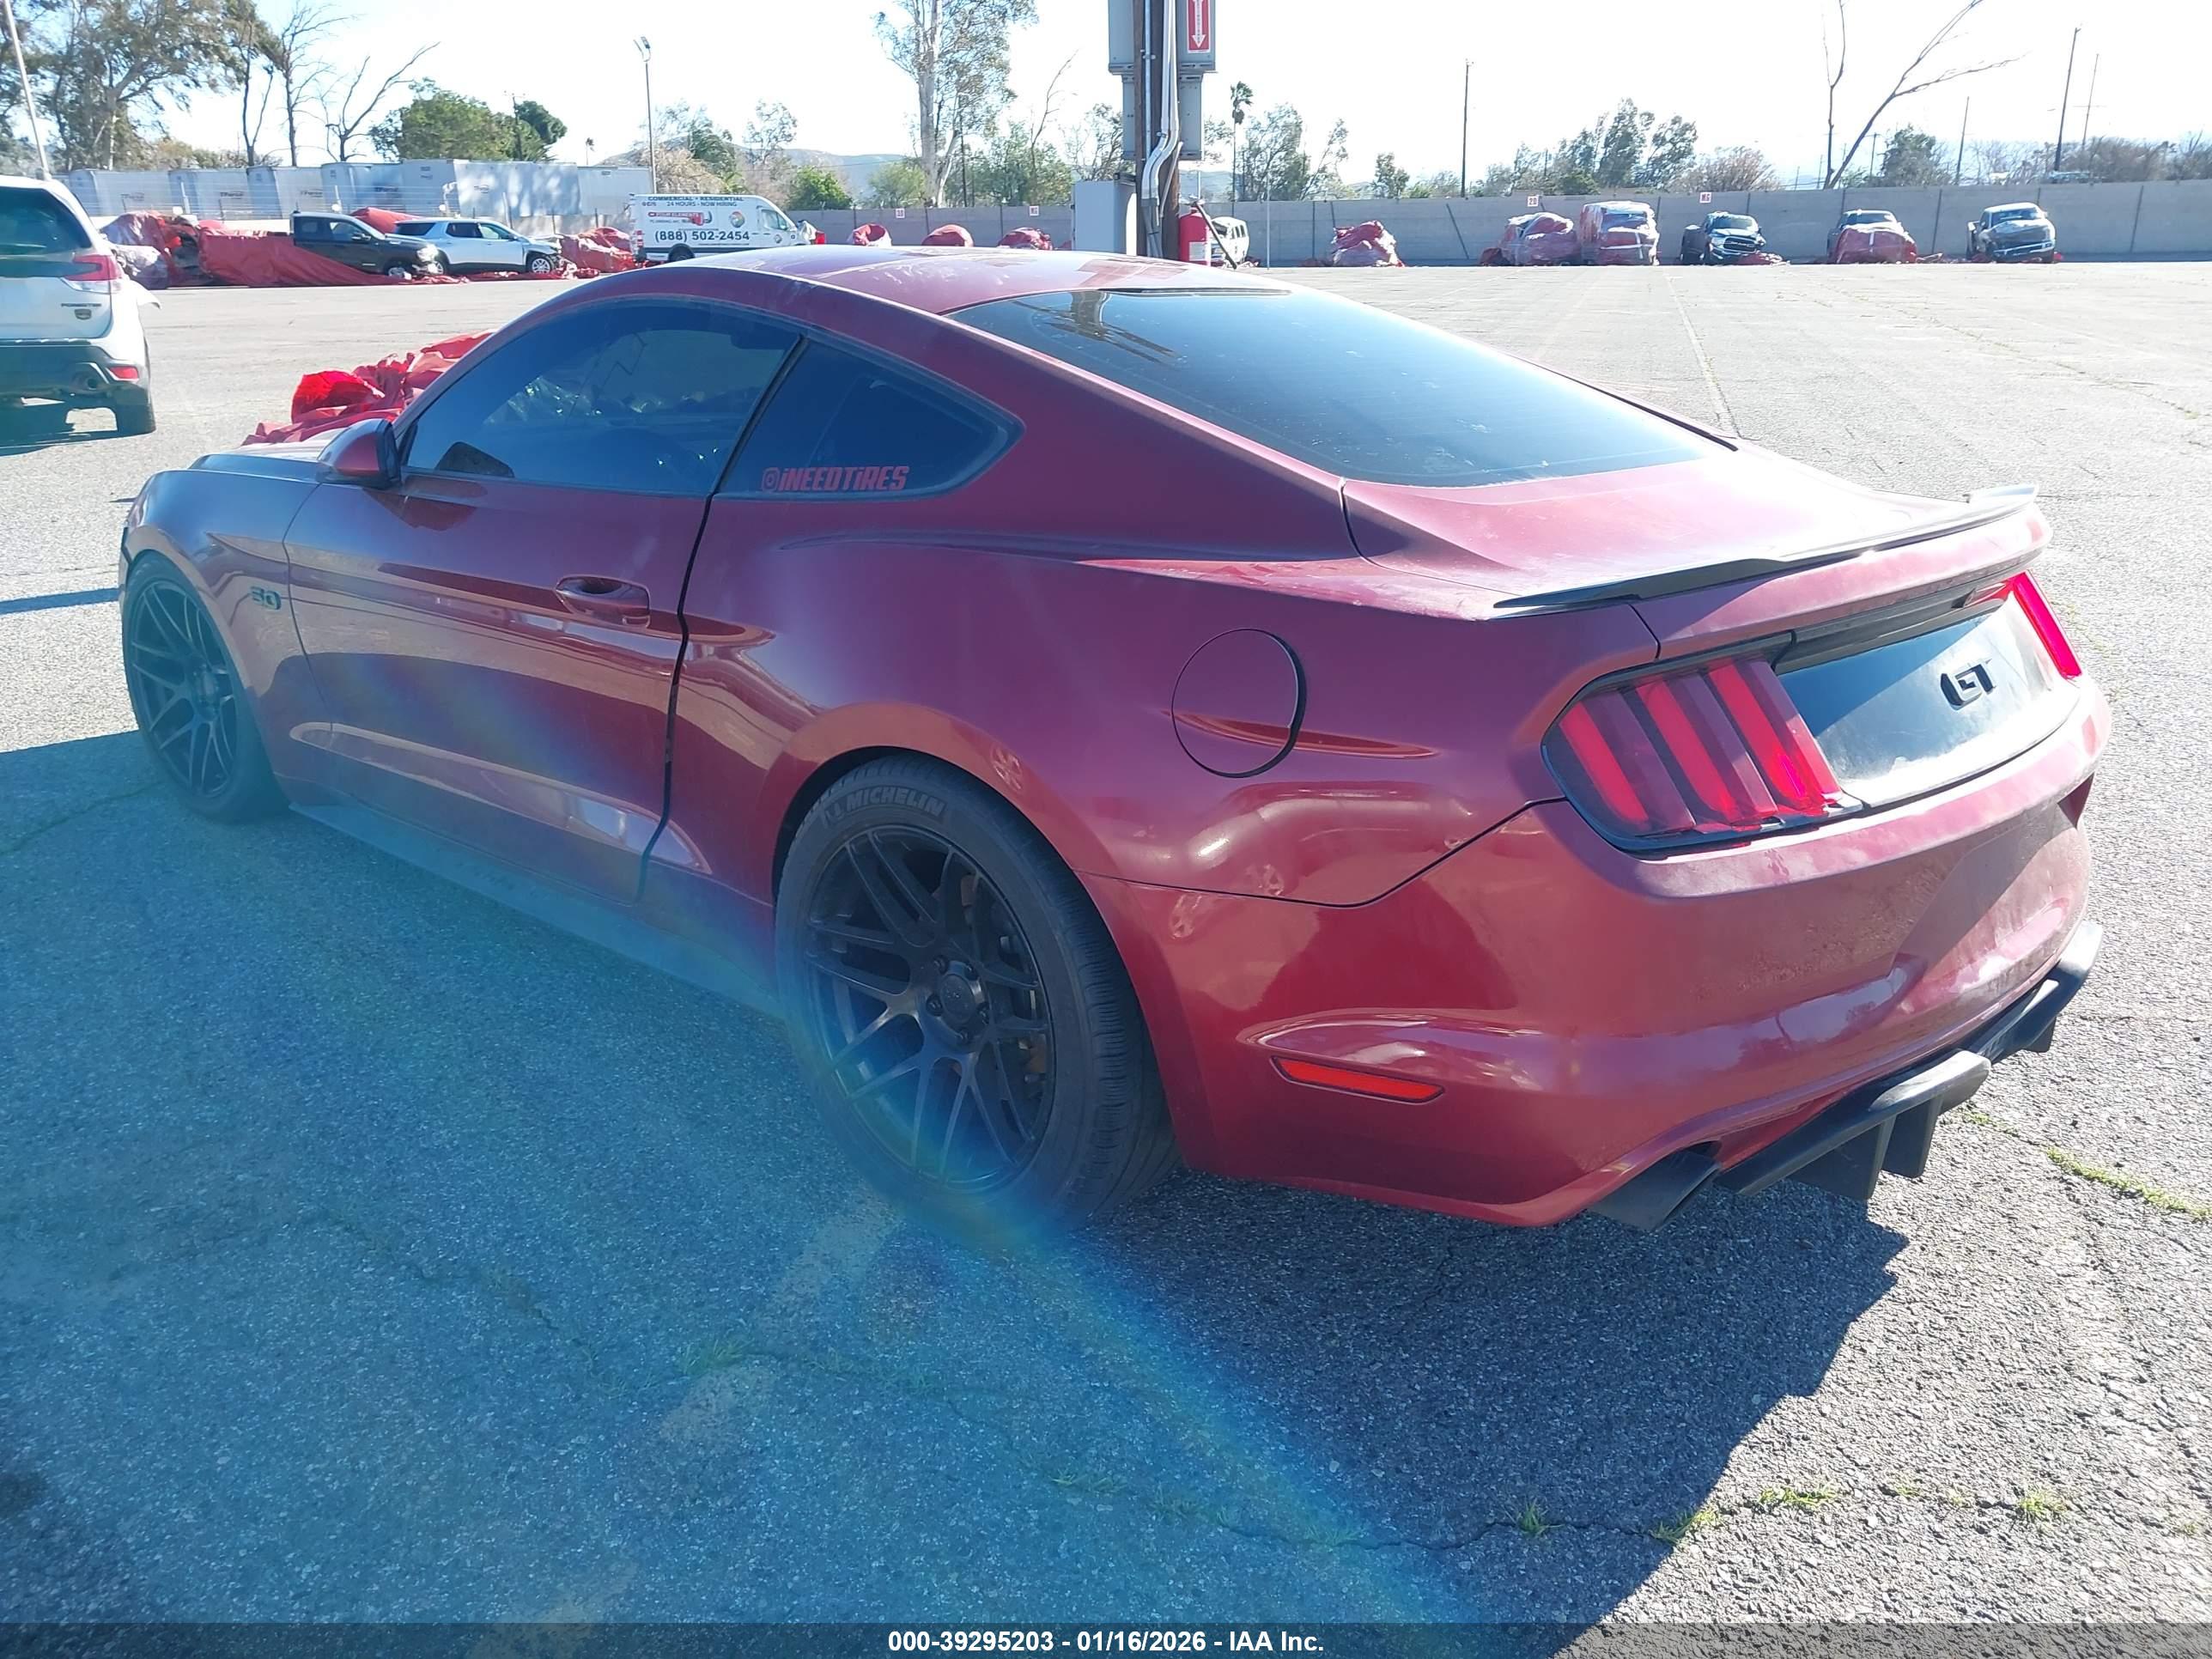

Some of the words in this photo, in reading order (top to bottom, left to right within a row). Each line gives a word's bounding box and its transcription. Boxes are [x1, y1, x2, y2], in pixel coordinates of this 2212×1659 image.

[654, 230, 688, 243] (888)
[692, 231, 750, 240] 502-2454
[1941, 663, 1994, 711] GT
[847, 785, 945, 817] MICHELIN
